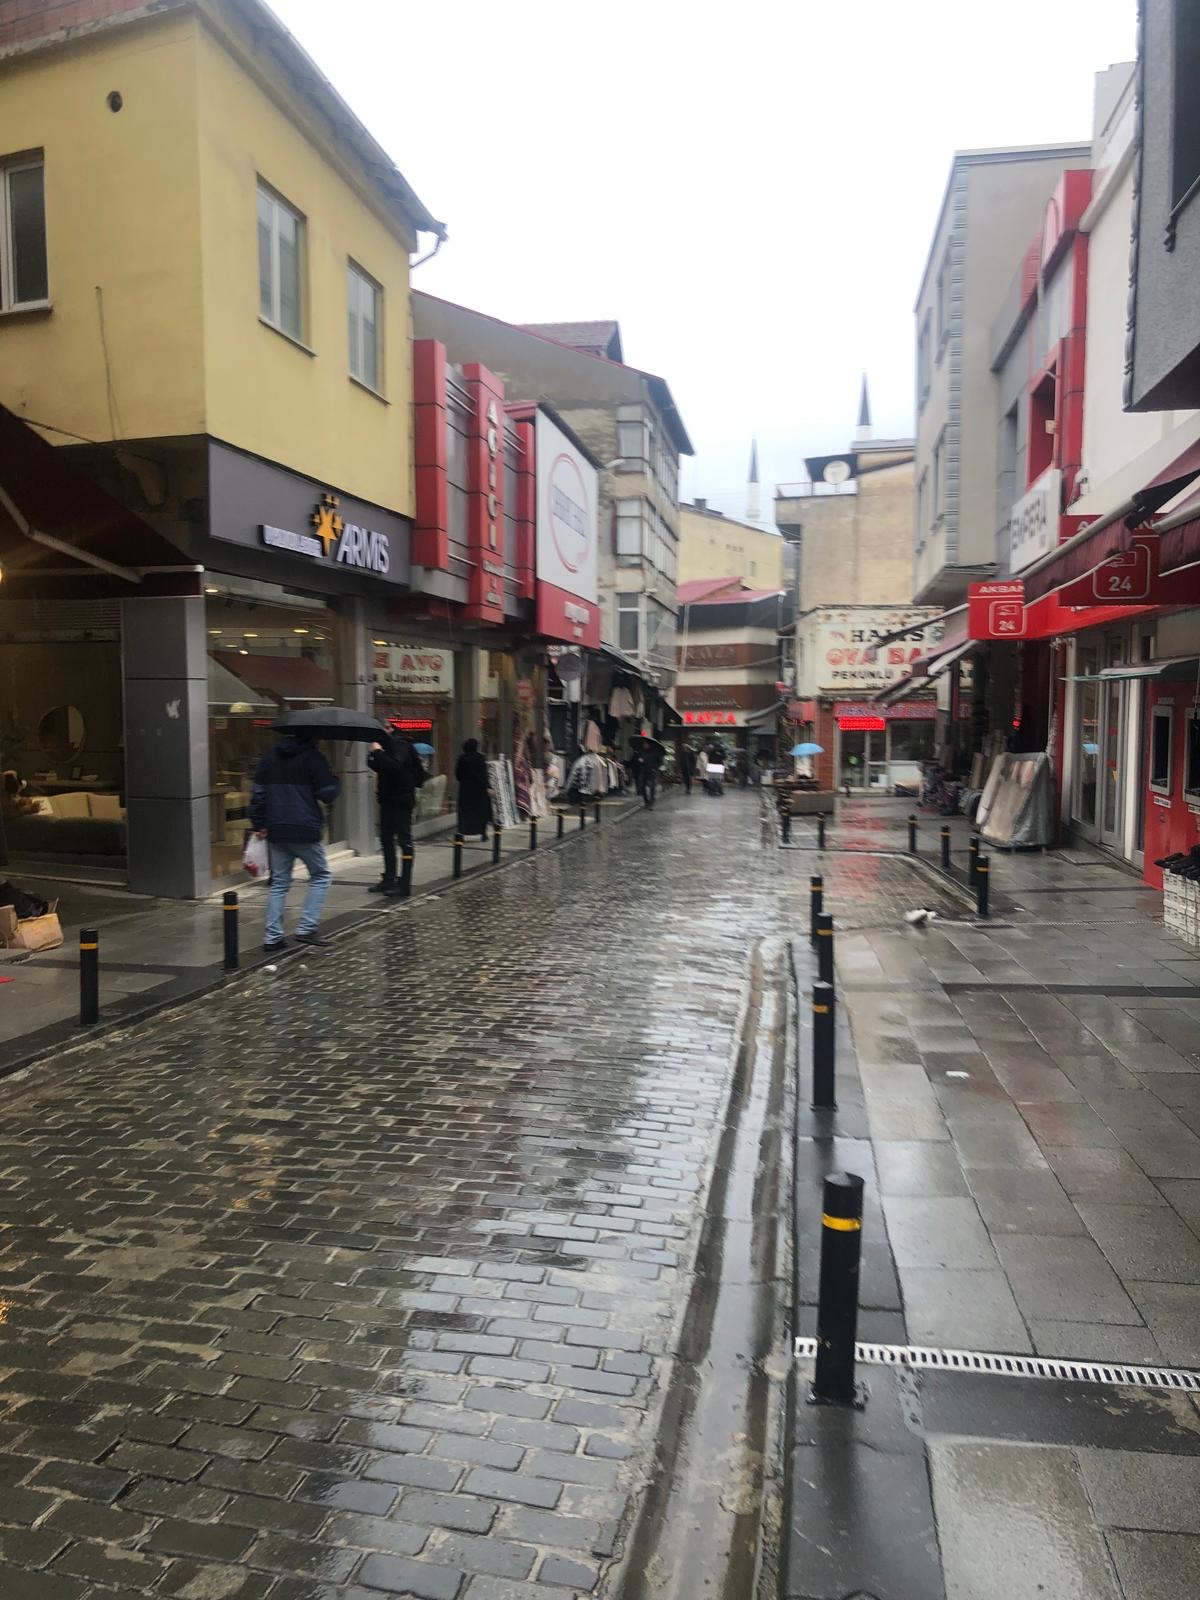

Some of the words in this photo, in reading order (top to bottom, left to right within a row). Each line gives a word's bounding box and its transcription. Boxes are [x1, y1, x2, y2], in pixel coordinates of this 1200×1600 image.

[1108, 576, 1132, 591] 24
[979, 585, 1025, 594] AKBAN
[998, 621, 1016, 631] 24
